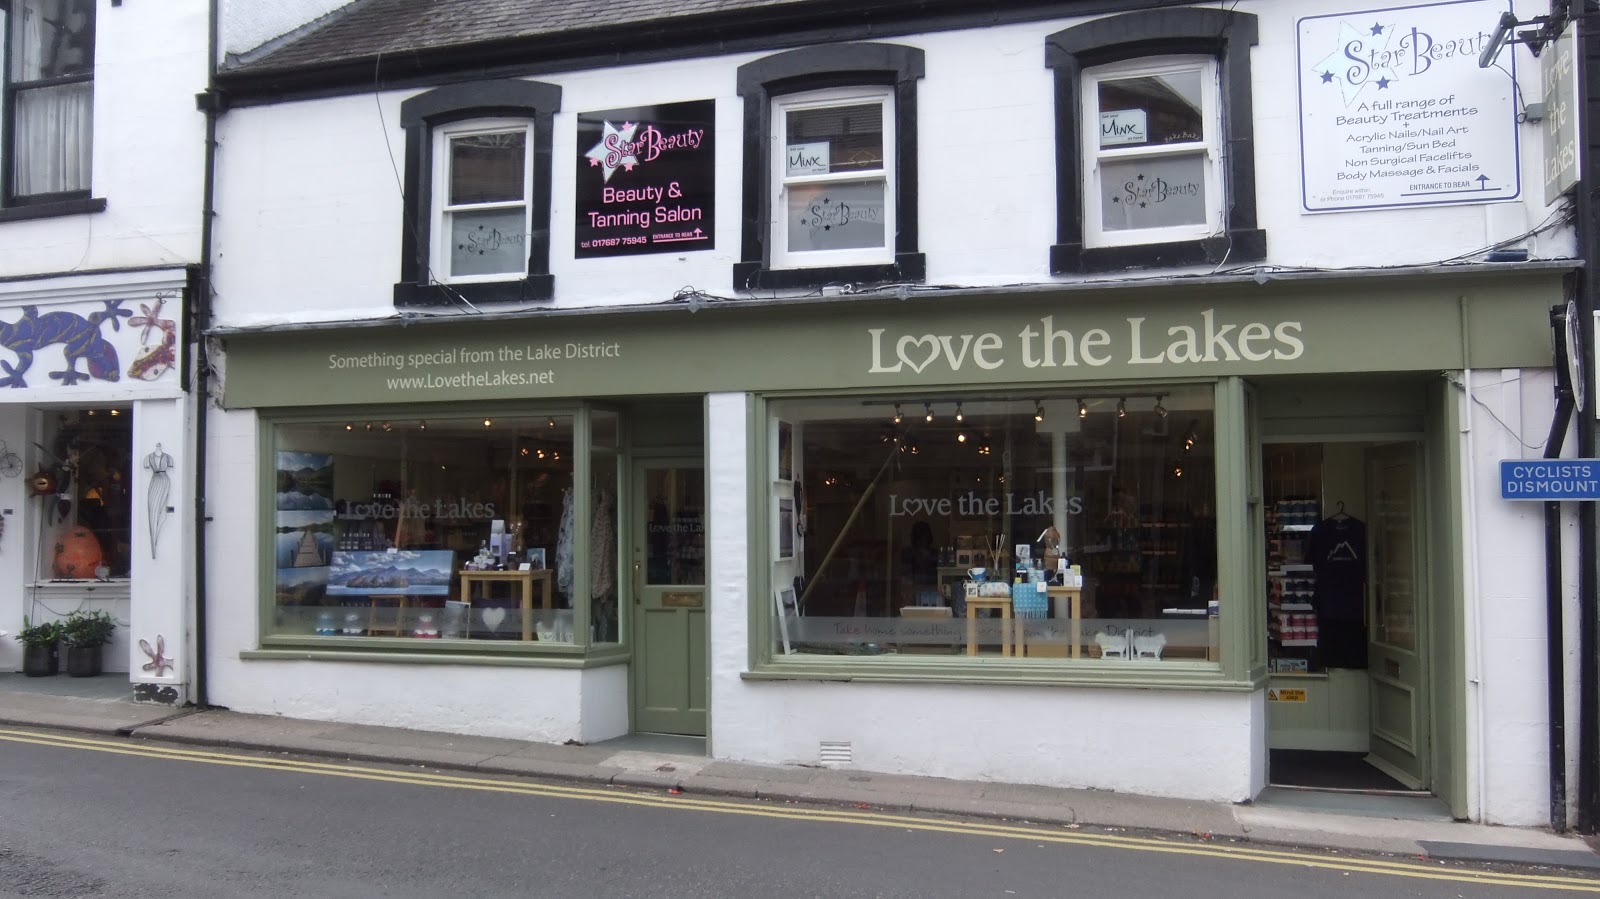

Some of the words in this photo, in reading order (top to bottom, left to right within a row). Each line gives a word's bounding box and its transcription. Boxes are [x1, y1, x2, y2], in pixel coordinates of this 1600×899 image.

[1357, 102, 1369, 112] A
[1372, 100, 1392, 112] full
[1395, 97, 1436, 110] range
[1439, 95, 1455, 105] of
[1336, 114, 1388, 126] Beauty
[1390, 105, 1479, 122] Treatments
[1549, 101, 1567, 137] the
[1346, 132, 1386, 143] Acrylic
[1388, 127, 1444, 139] Nails/Nail
[1446, 125, 1469, 135] Art
[1359, 141, 1430, 154] Tanning/Sun
[1432, 139, 1456, 148] Bed
[1345, 159, 1368, 168] Non
[1370, 154, 1417, 167] Surgical
[1419, 151, 1472, 163] Facelifts
[1545, 139, 1575, 187] Lakes
[1337, 171, 1367, 181] Body
[1369, 167, 1424, 179] Massage
[1425, 165, 1436, 174] &
[1438, 163, 1480, 174] Facials
[603, 184, 664, 204] Beauty
[668, 182, 683, 198] &
[1409, 182, 1443, 191] ENTRANCE
[588, 209, 650, 229] Tanning
[655, 205, 702, 223] Salon
[592, 238, 620, 248] 017687
[622, 236, 647, 246] 75945
[868, 328, 1004, 374] Love
[1018, 315, 1112, 368] the
[1126, 308, 1304, 364] Lakes
[329, 352, 404, 370] Something
[408, 348, 456, 369] special
[460, 347, 495, 364] from
[498, 346, 523, 362] the
[527, 344, 561, 360] Lake
[565, 342, 620, 358] District
[387, 370, 554, 390] www.LovetheLakes.net
[1513, 465, 1592, 478] CYCLISTS
[1507, 480, 1598, 492] DISMOUNT
[398, 498, 431, 519] the
[434, 497, 496, 519] Lakes
[958, 492, 999, 516] the
[833, 622, 860, 636] Take
[864, 624, 896, 636] home
